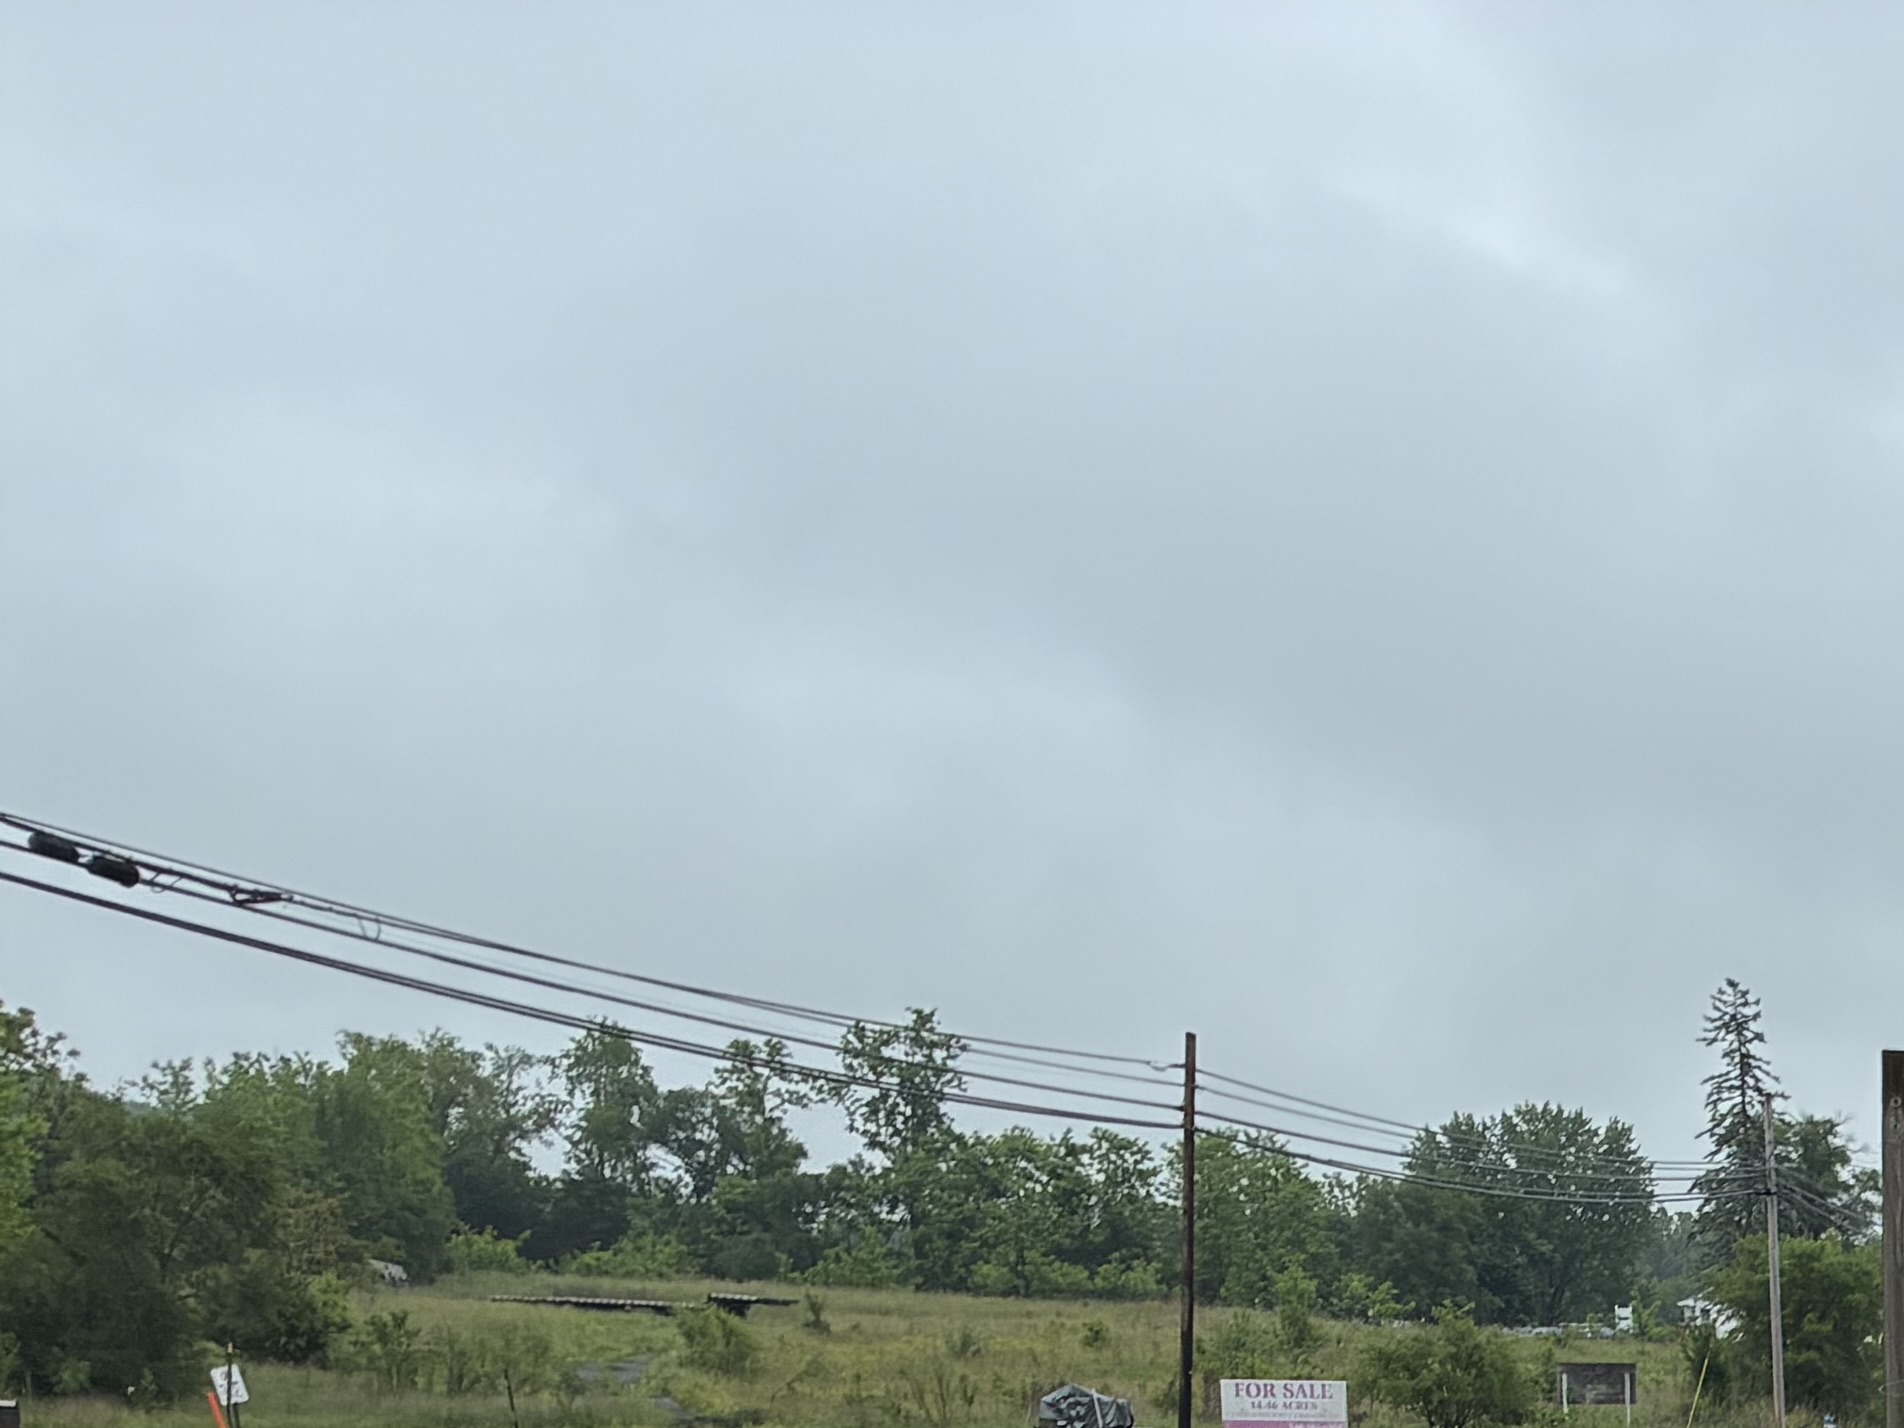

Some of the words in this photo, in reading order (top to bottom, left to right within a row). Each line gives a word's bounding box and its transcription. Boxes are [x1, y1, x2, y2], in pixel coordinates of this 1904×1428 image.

[1234, 1382, 1277, 1400] FOR
[1282, 1383, 1334, 1400] SALE
[1281, 1401, 1318, 1411] ACRES
